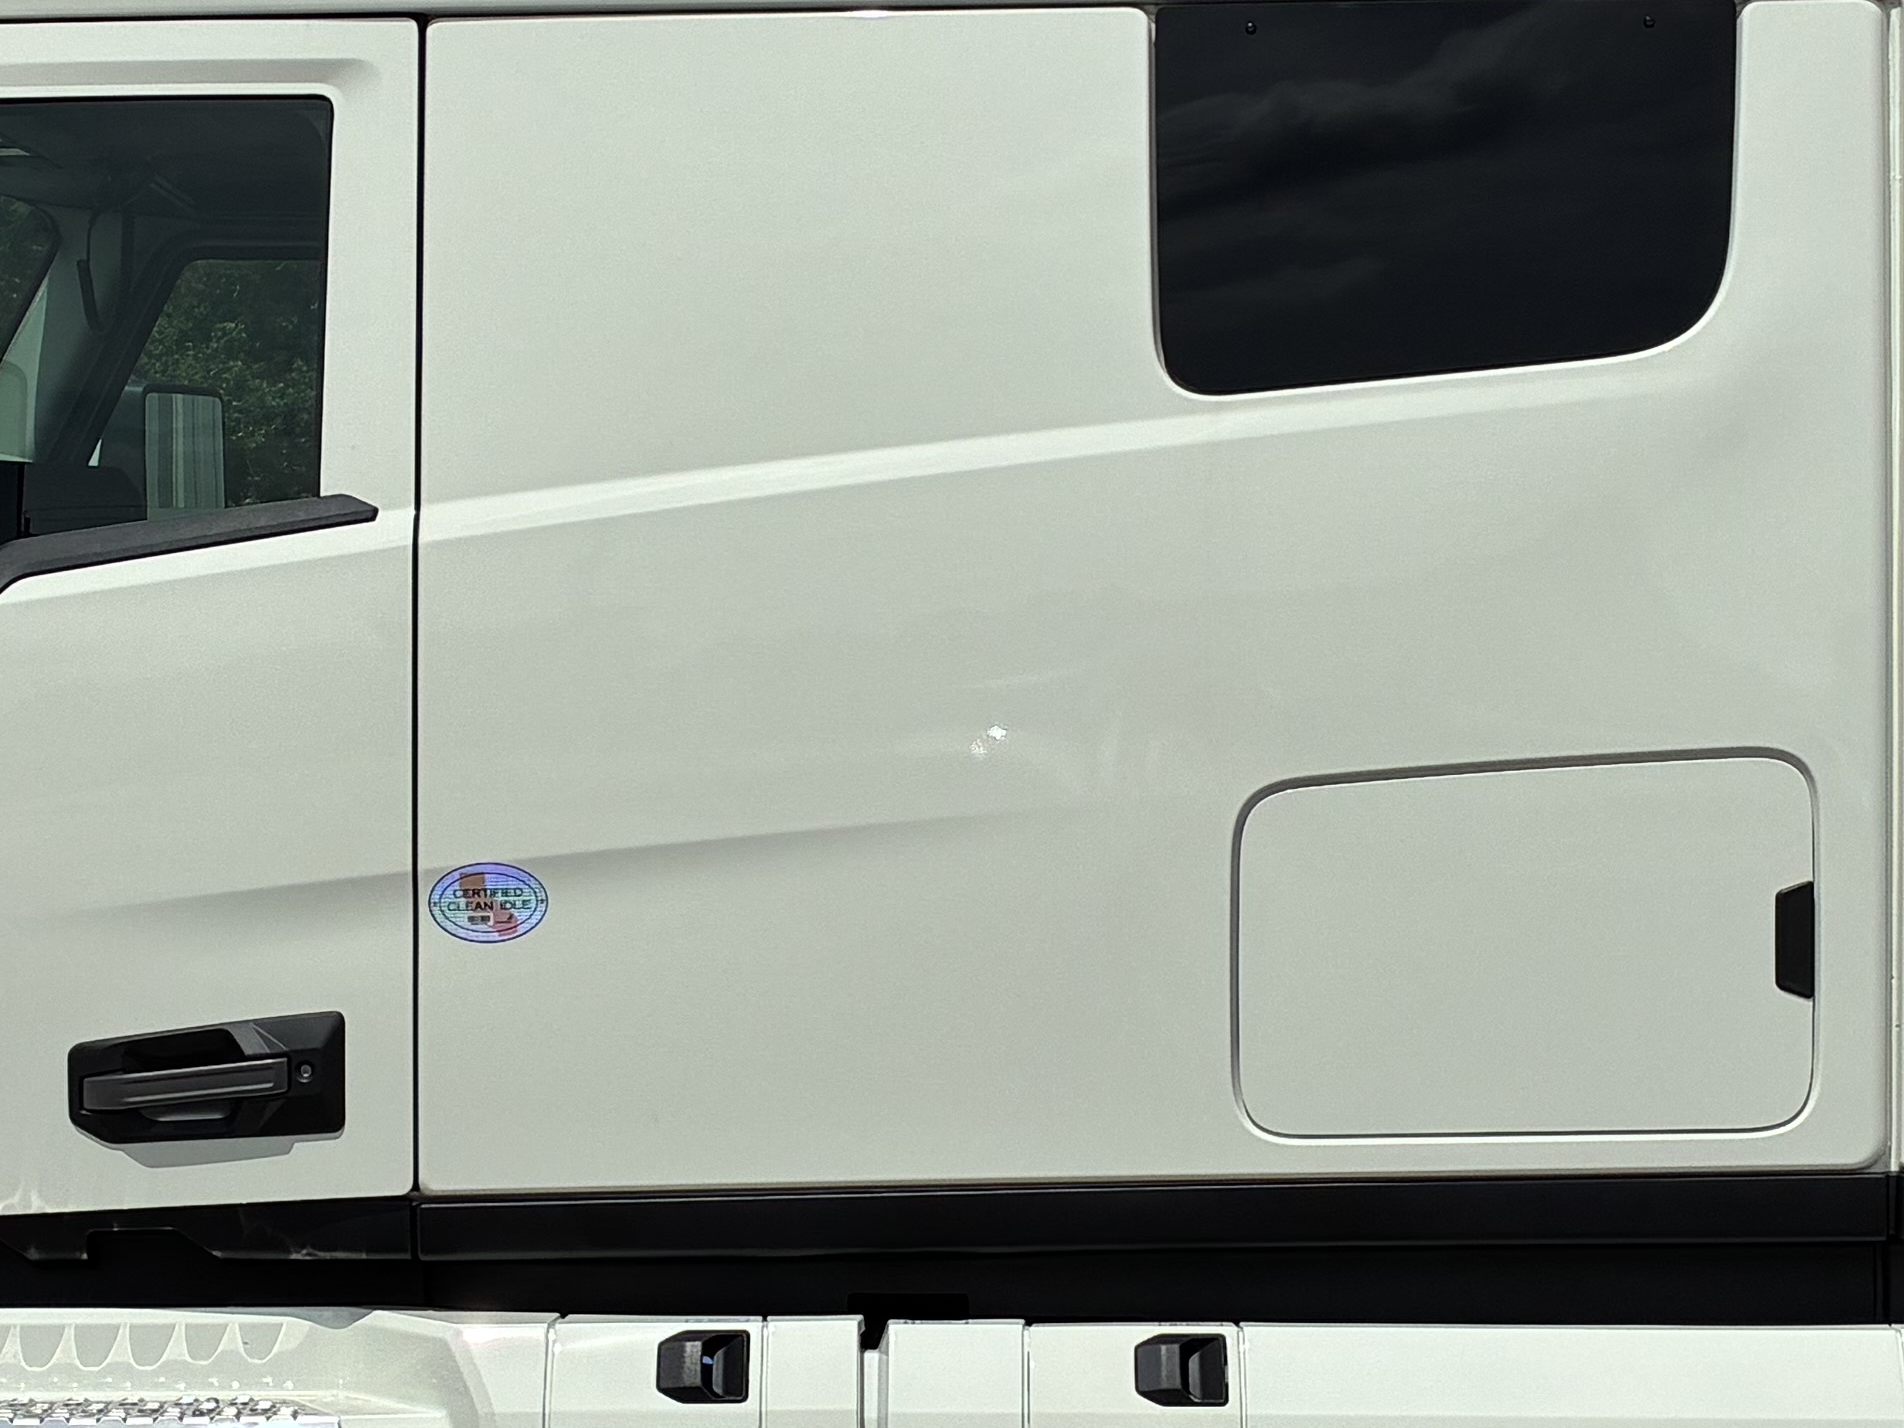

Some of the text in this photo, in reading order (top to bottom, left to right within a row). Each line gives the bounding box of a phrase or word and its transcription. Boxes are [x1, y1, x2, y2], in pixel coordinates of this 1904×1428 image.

[452, 887, 524, 899] CERTIFIED
[446, 898, 532, 912] CLEAN IDLE
